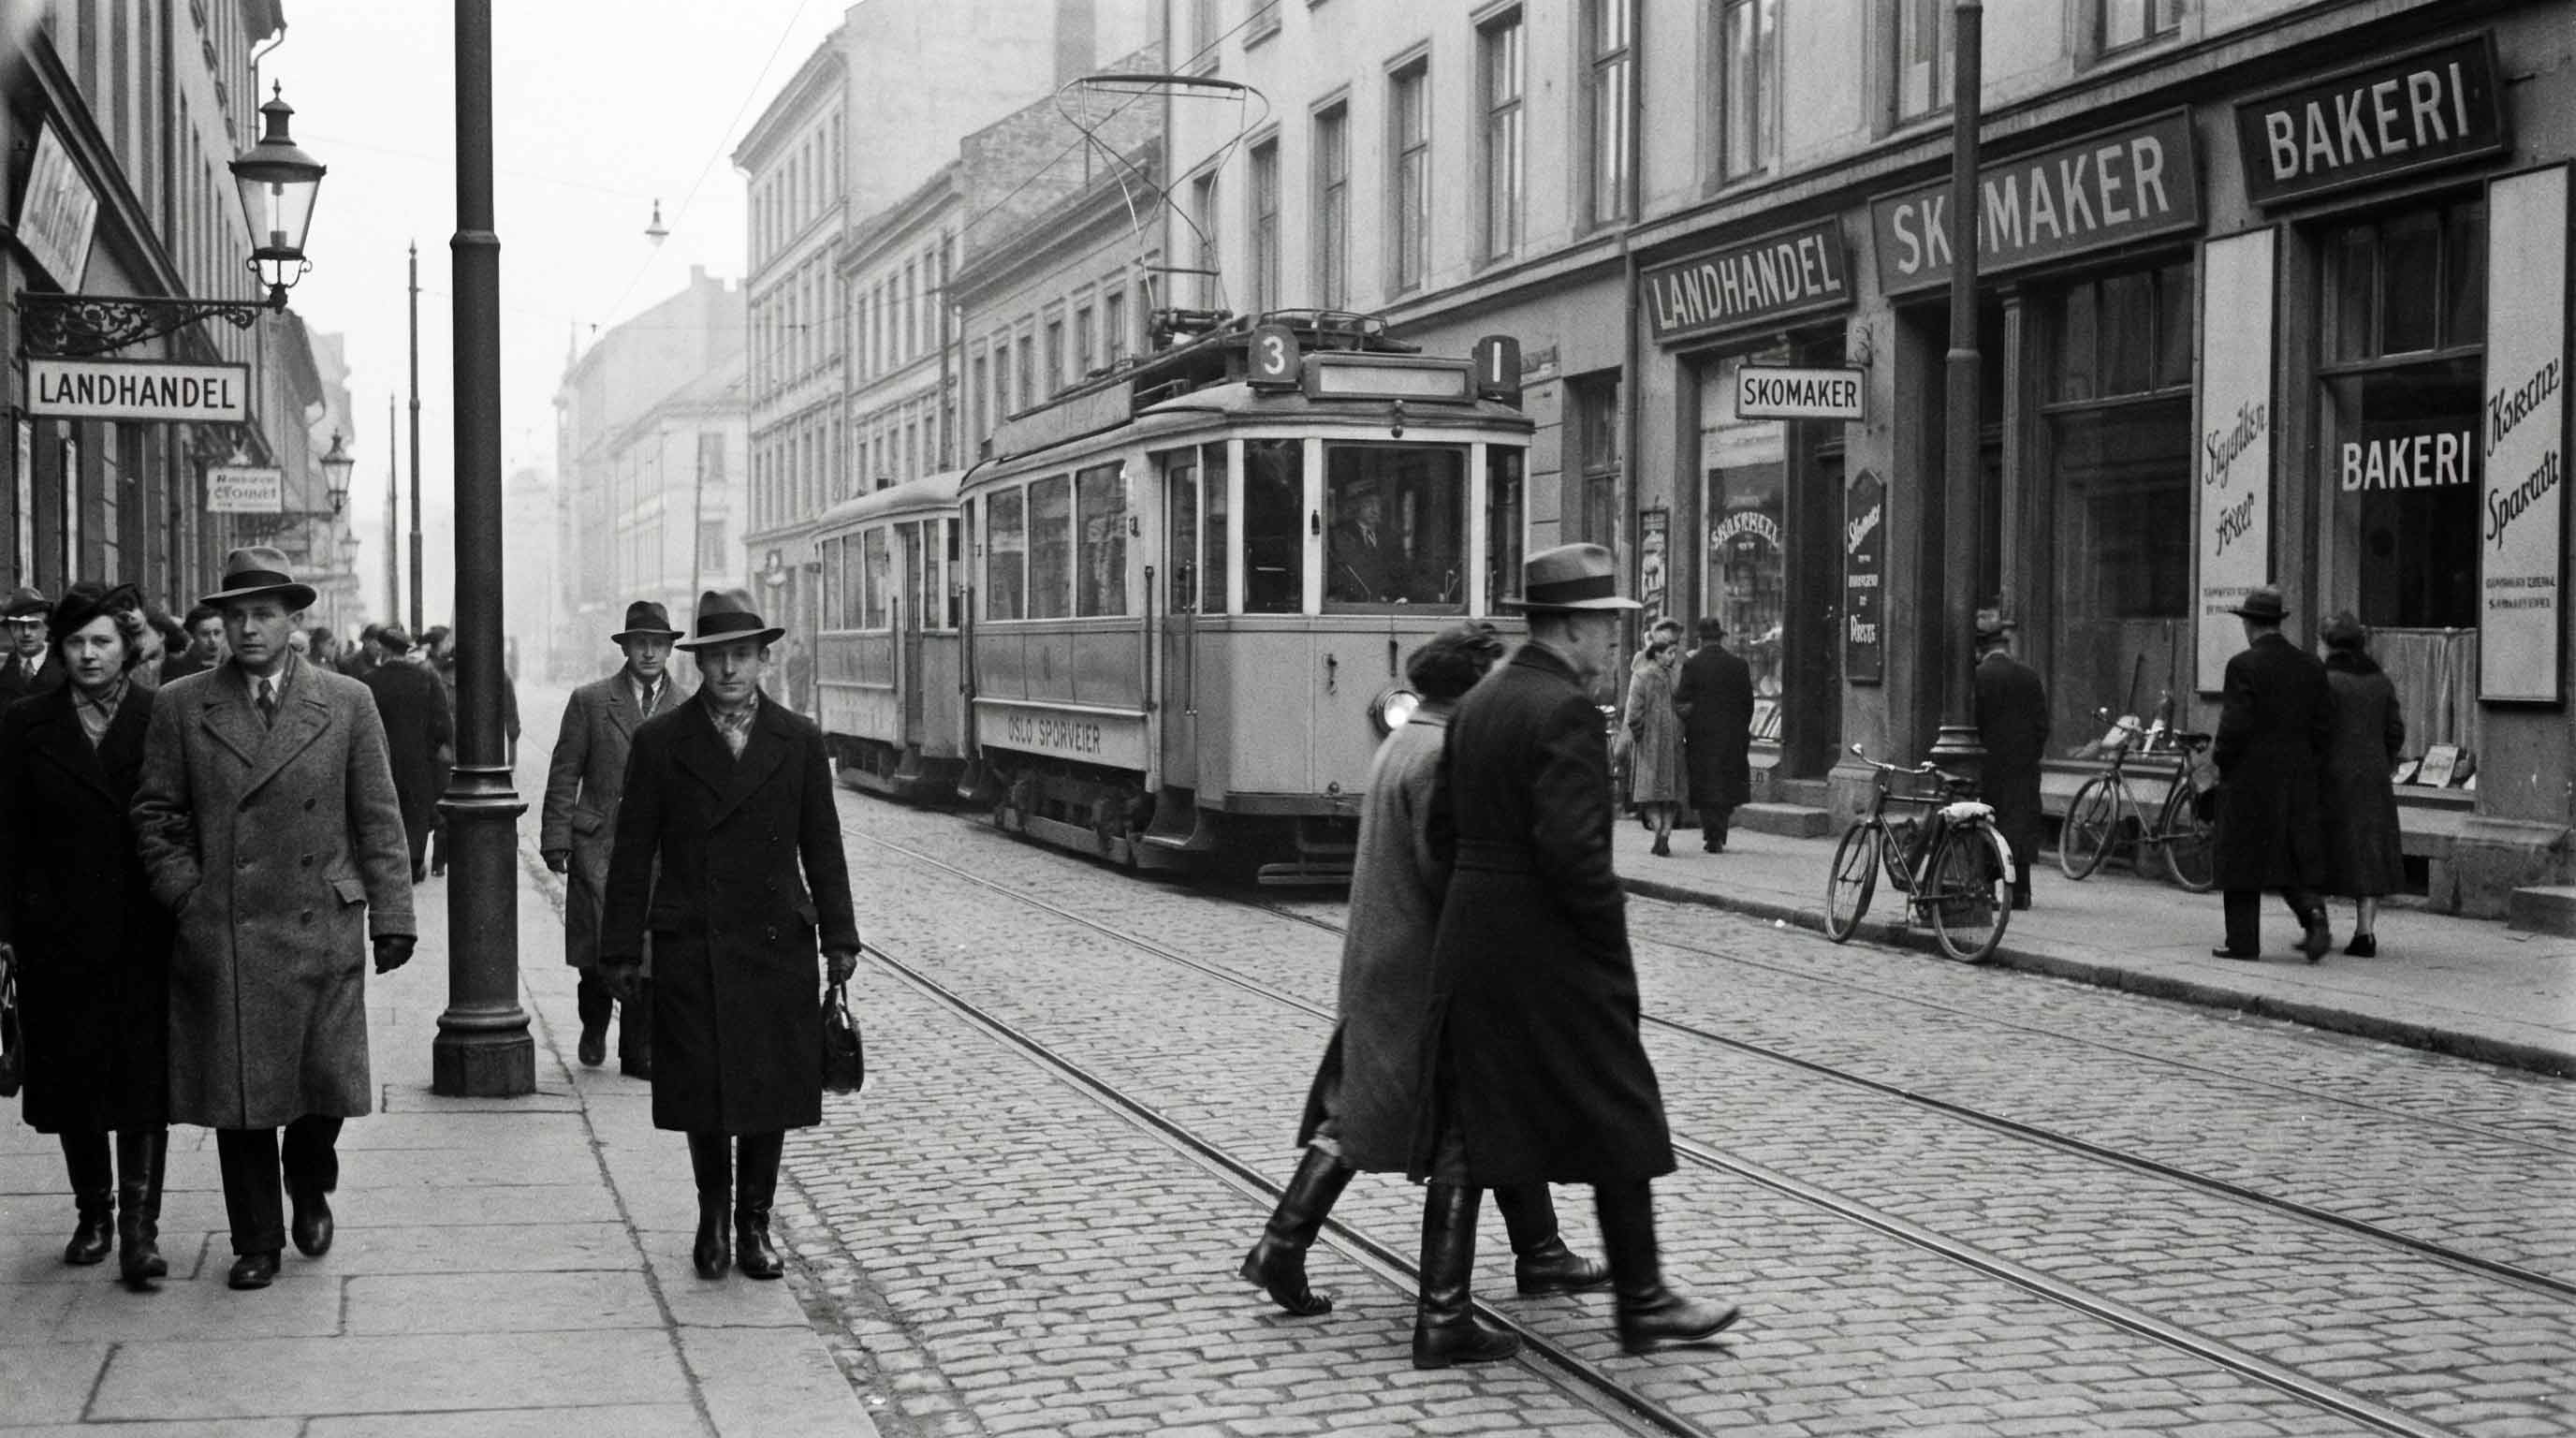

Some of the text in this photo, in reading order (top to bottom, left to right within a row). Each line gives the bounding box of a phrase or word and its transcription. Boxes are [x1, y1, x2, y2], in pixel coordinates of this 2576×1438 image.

[2265, 62, 2469, 181] BAKERI
[1893, 136, 2170, 275] SKMAKER
[1653, 234, 1841, 330] LANDHANDEL
[1264, 335, 1285, 374] 3
[40, 373, 236, 409] LANDHANDEL
[1744, 378, 1857, 408] SKOMAKER
[2342, 431, 2471, 492] BAKERI
[1008, 715, 1101, 755] OSLO SPORVEIER
